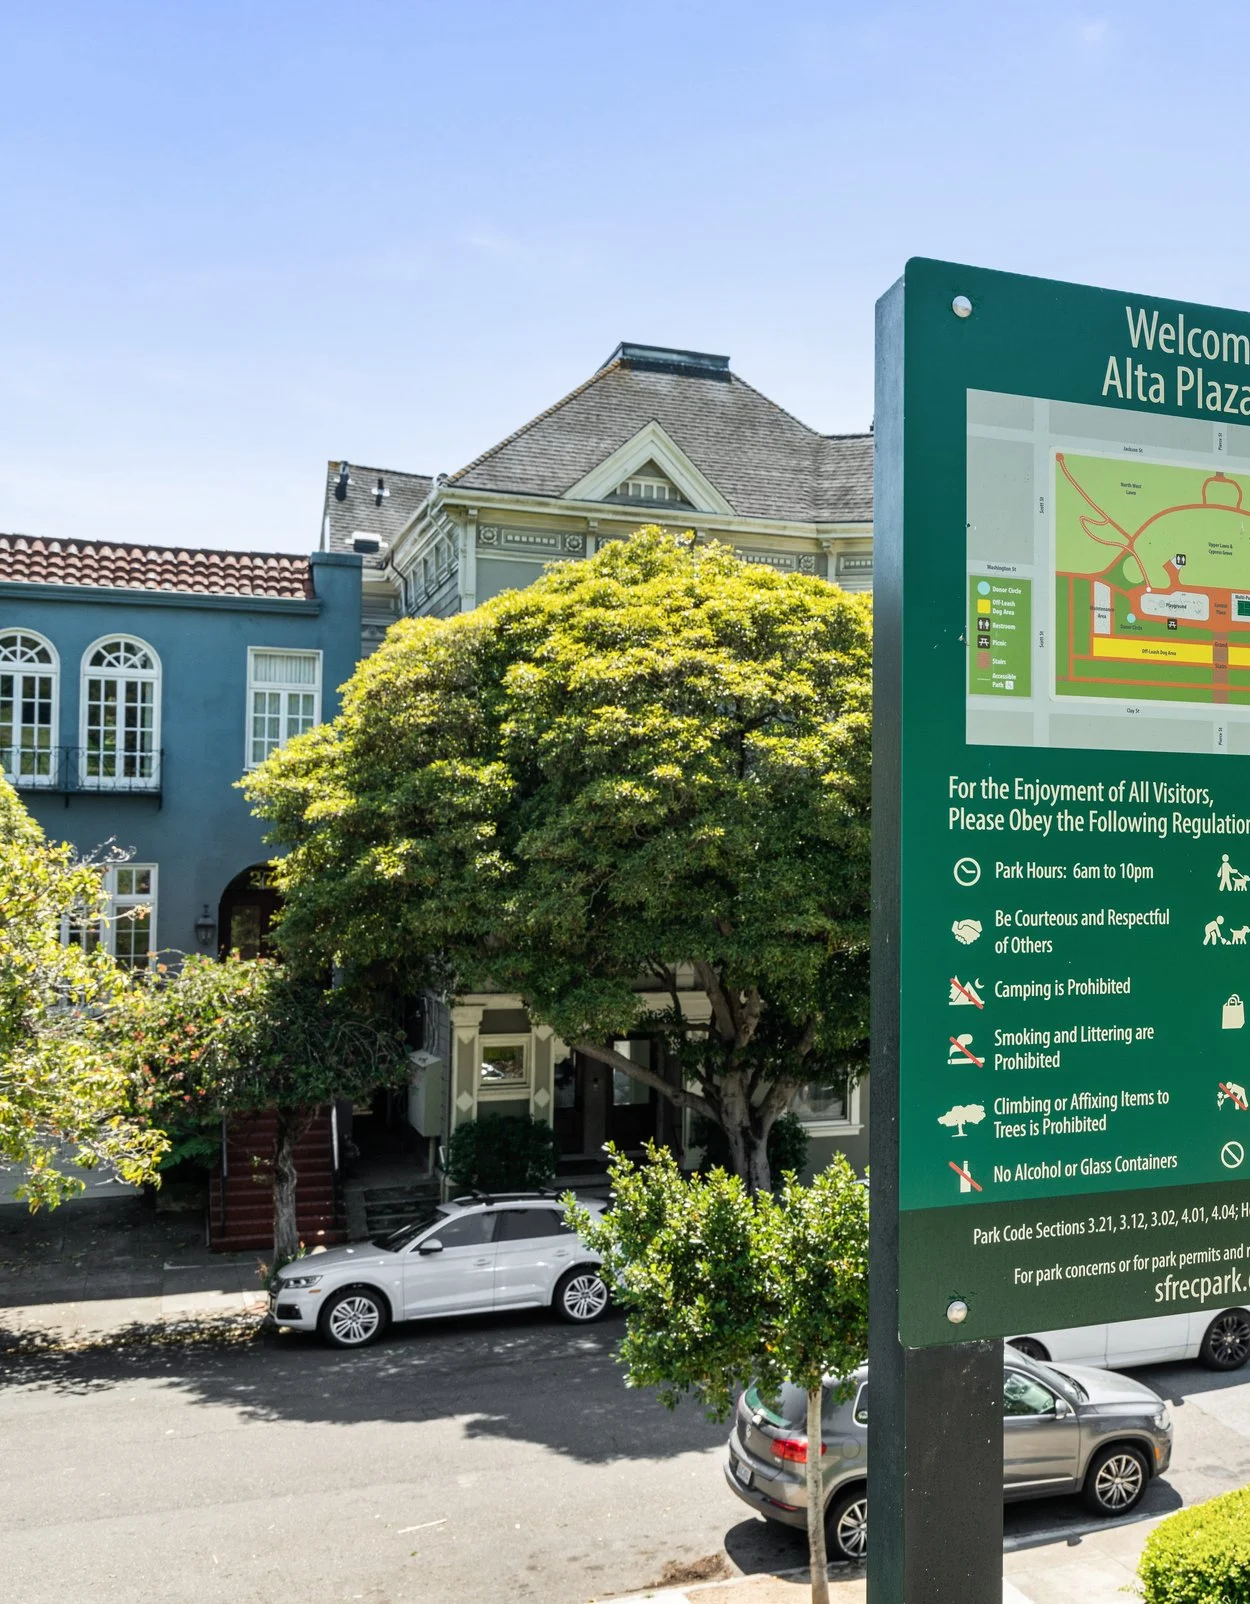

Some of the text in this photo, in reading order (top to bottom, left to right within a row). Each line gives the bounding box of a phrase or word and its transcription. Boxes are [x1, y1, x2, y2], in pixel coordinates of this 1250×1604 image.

[1102, 356, 1164, 404] Alta
[950, 776, 1213, 807] For the Enjoyment of All Visitors,
[950, 807, 1004, 830] Please
[1010, 809, 1052, 837] Obey
[1057, 810, 1084, 831] the
[1090, 810, 1167, 838] Following
[996, 862, 1153, 882] Park Hours: 6am to 10pm
[996, 909, 1169, 929] Be Courteous and Respectful
[995, 936, 1052, 953] of Others
[995, 977, 1130, 1001] Camping is Prohibited
[995, 1026, 1154, 1048] Smoking and Littering are
[995, 1051, 1060, 1070] Prohibited
[994, 1090, 1169, 1116] Climbing or Affixing Items to
[994, 1114, 1106, 1138] Trees is Prohibited
[994, 1154, 1177, 1182] No Alcohol or Glass Containers
[974, 1227, 1000, 1244] Park
[1004, 1224, 1033, 1241] Code
[1036, 1221, 1085, 1238] Sections
[1088, 1216, 1116, 1233] 3.21,
[1120, 1213, 1148, 1230] 3.12,
[1151, 1210, 1178, 1226] 3.02,
[1181, 1207, 1208, 1223] 4.01,
[1212, 1204, 1238, 1220] 4.04;
[1015, 1268, 1033, 1284] For
[1036, 1264, 1062, 1286] park
[1065, 1262, 1116, 1278] concerns
[1119, 1260, 1131, 1272] or
[1133, 1255, 1149, 1270] for
[1152, 1251, 1176, 1272] park
[1180, 1248, 1221, 1269] permits
[1224, 1243, 1243, 1260] and
